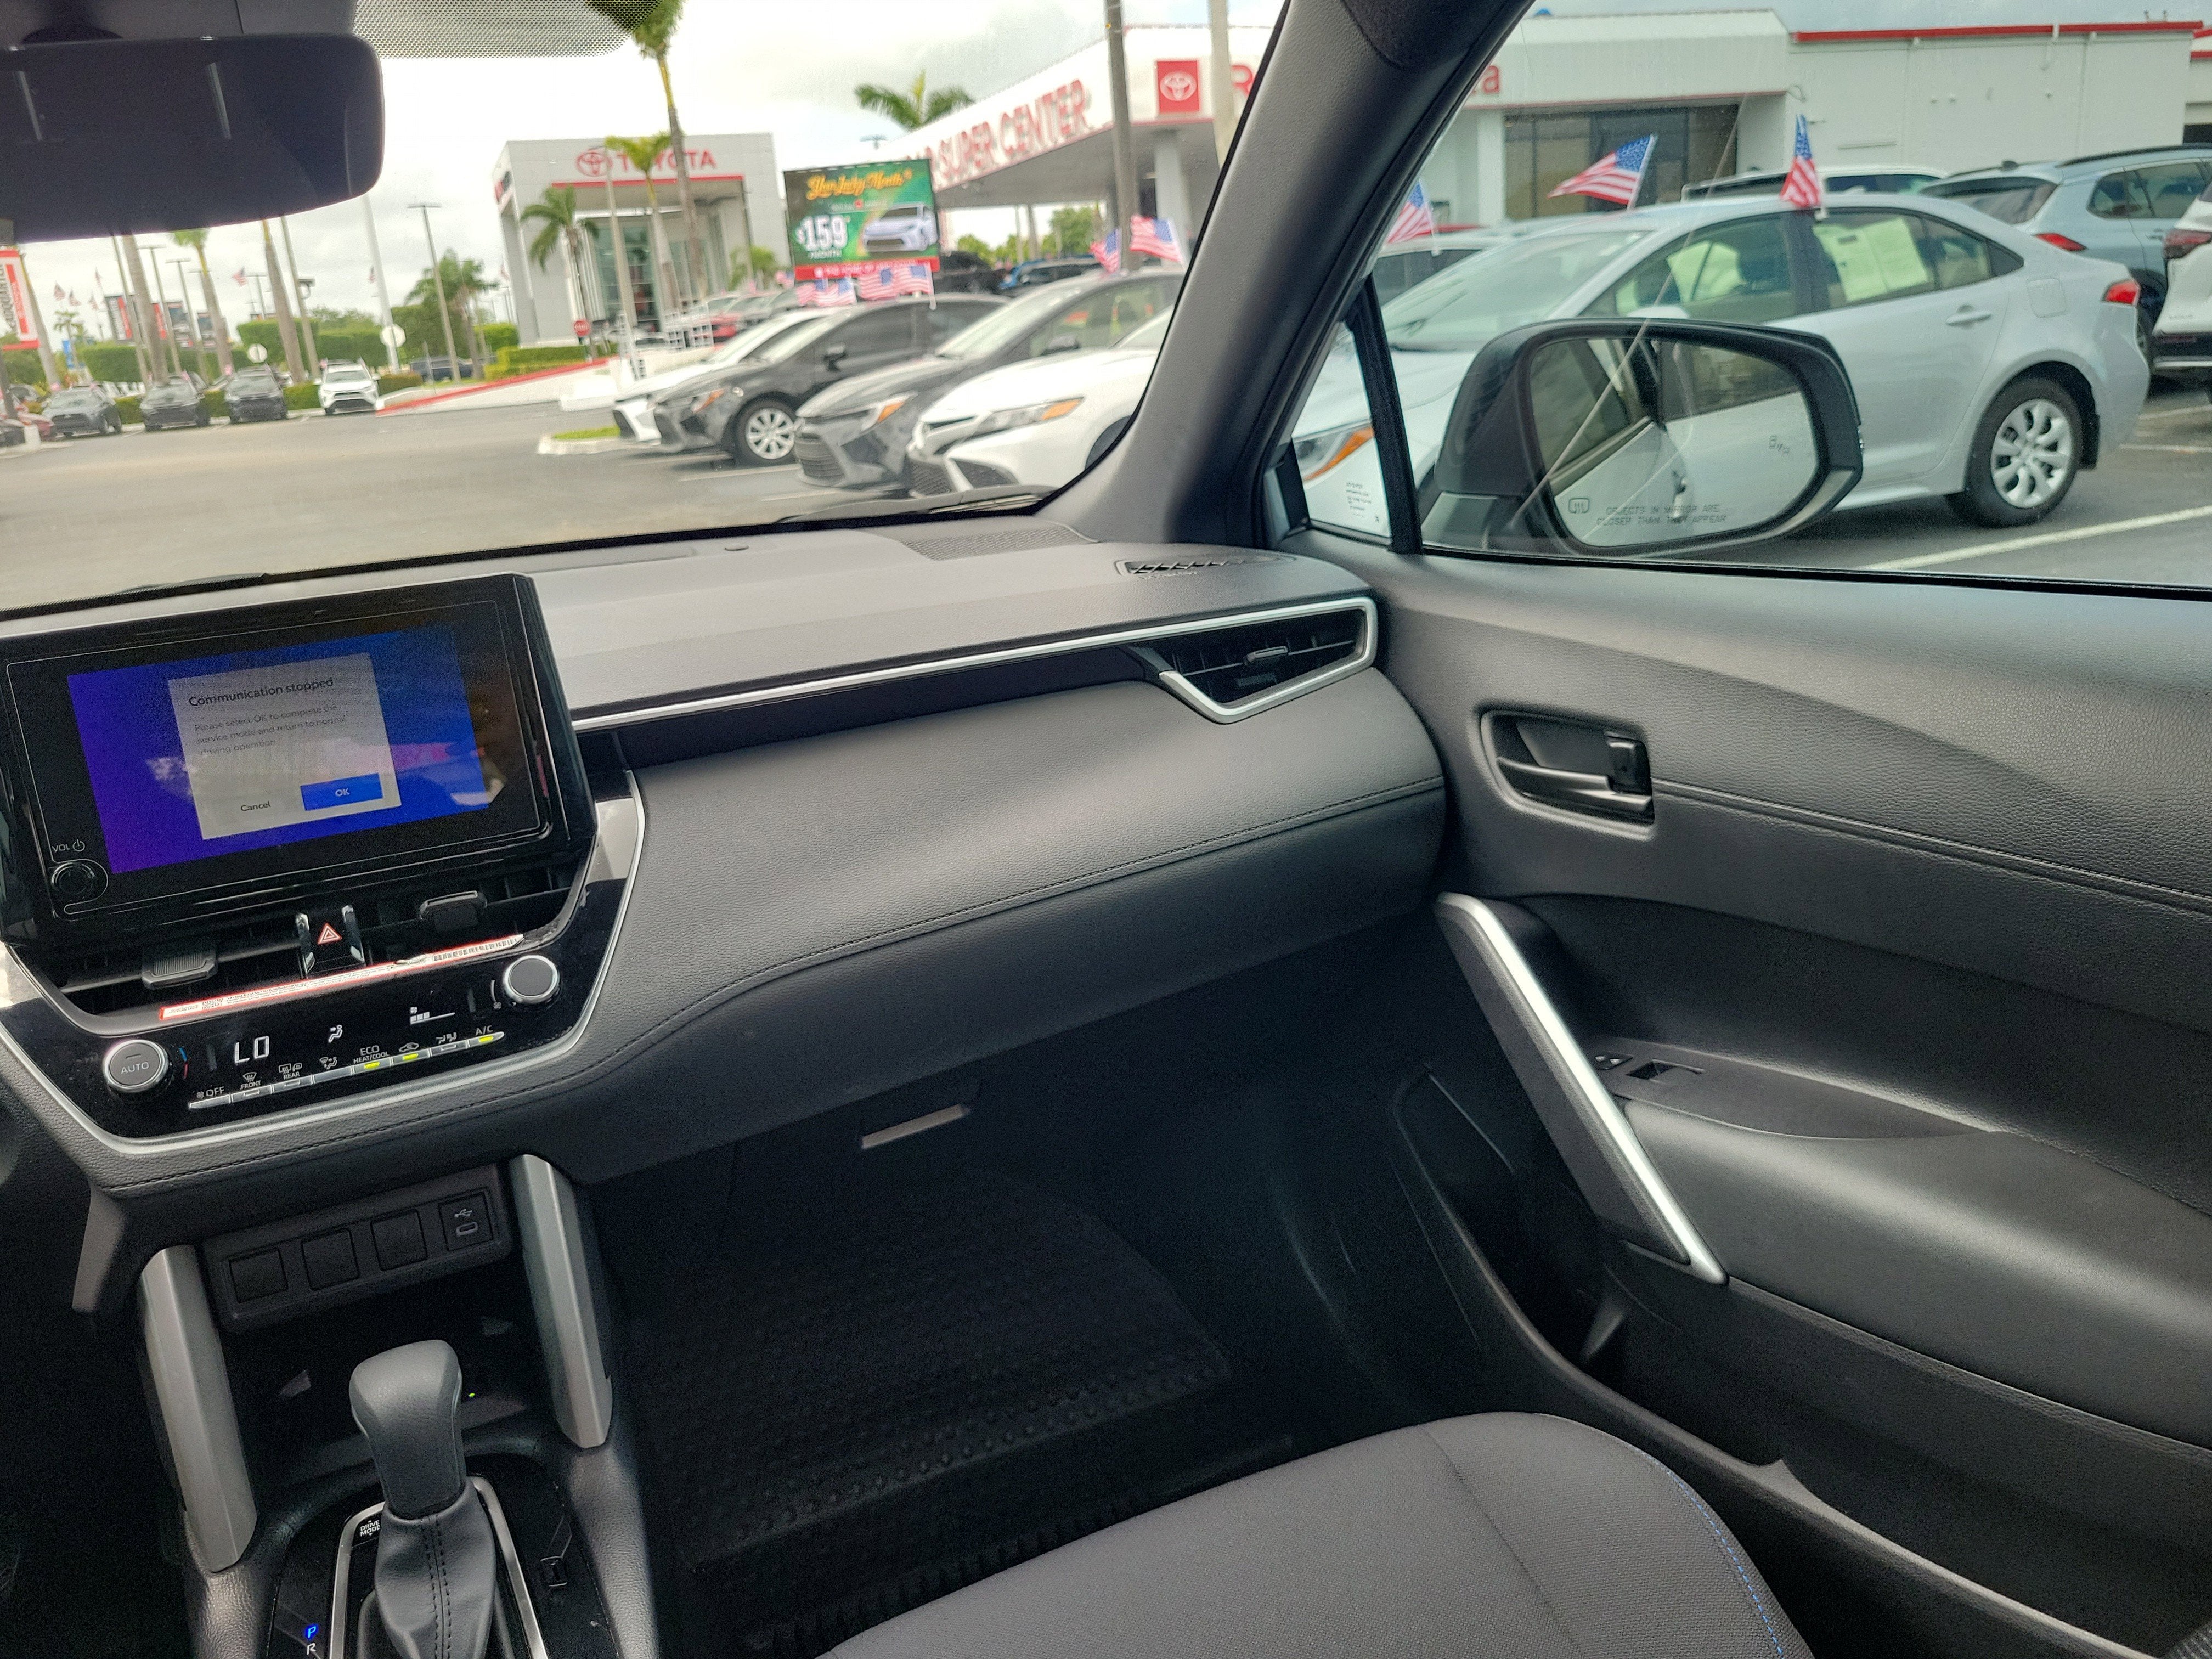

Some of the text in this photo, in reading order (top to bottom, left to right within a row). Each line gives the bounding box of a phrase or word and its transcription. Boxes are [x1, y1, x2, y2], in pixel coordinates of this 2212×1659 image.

[940, 120, 996, 181] SUPER
[999, 78, 1088, 159] CENTER
[616, 149, 718, 172] TYOTA
[1692, 515, 1726, 523] APPEAR
[189, 677, 334, 707] Communication stopped
[195, 723, 224, 731] Please
[225, 718, 252, 727] select
[253, 714, 266, 723] OK
[281, 707, 322, 718] complete
[198, 733, 229, 744] service
[230, 730, 256, 739] mode
[258, 726, 274, 735] and
[317, 714, 346, 725] normal
[201, 740, 276, 755] driving operation
[335, 788, 350, 797] OK
[240, 800, 272, 812] Cancel
[52, 844, 71, 853] VOL
[475, 1025, 494, 1036] A/C
[360, 1045, 380, 1057] ECO
[353, 1051, 390, 1064] HEAT/COOL
[121, 1062, 149, 1074] AUTO
[283, 1071, 300, 1080] REAR
[240, 1079, 261, 1090] FRONT
[206, 1086, 225, 1098] OFF
[360, 1519, 380, 1532] DRIVE
[360, 1525, 381, 1537] MODE
[307, 1626, 317, 1638] P
[306, 1642, 317, 1655] R
